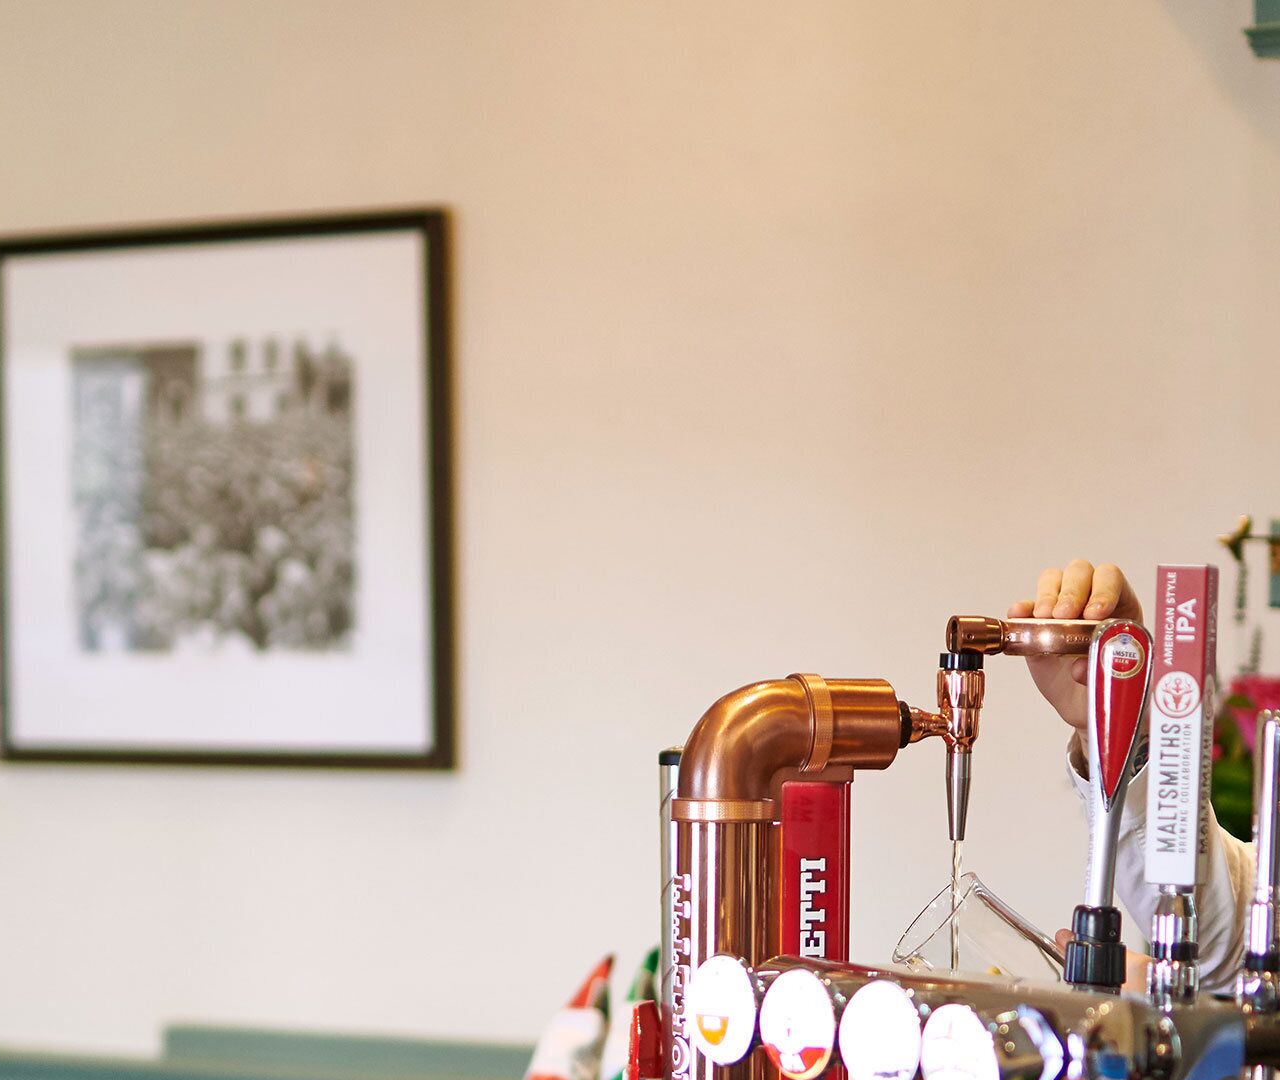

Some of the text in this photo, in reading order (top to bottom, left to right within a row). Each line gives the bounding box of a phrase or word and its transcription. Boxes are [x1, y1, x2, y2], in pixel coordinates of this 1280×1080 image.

[1163, 571, 1177, 667] AMERICAN STYLE
[1175, 598, 1197, 641] IPA
[1156, 722, 1181, 853] MALTSMITHS
[1178, 723, 1192, 854] BREWING COLLABORATION
